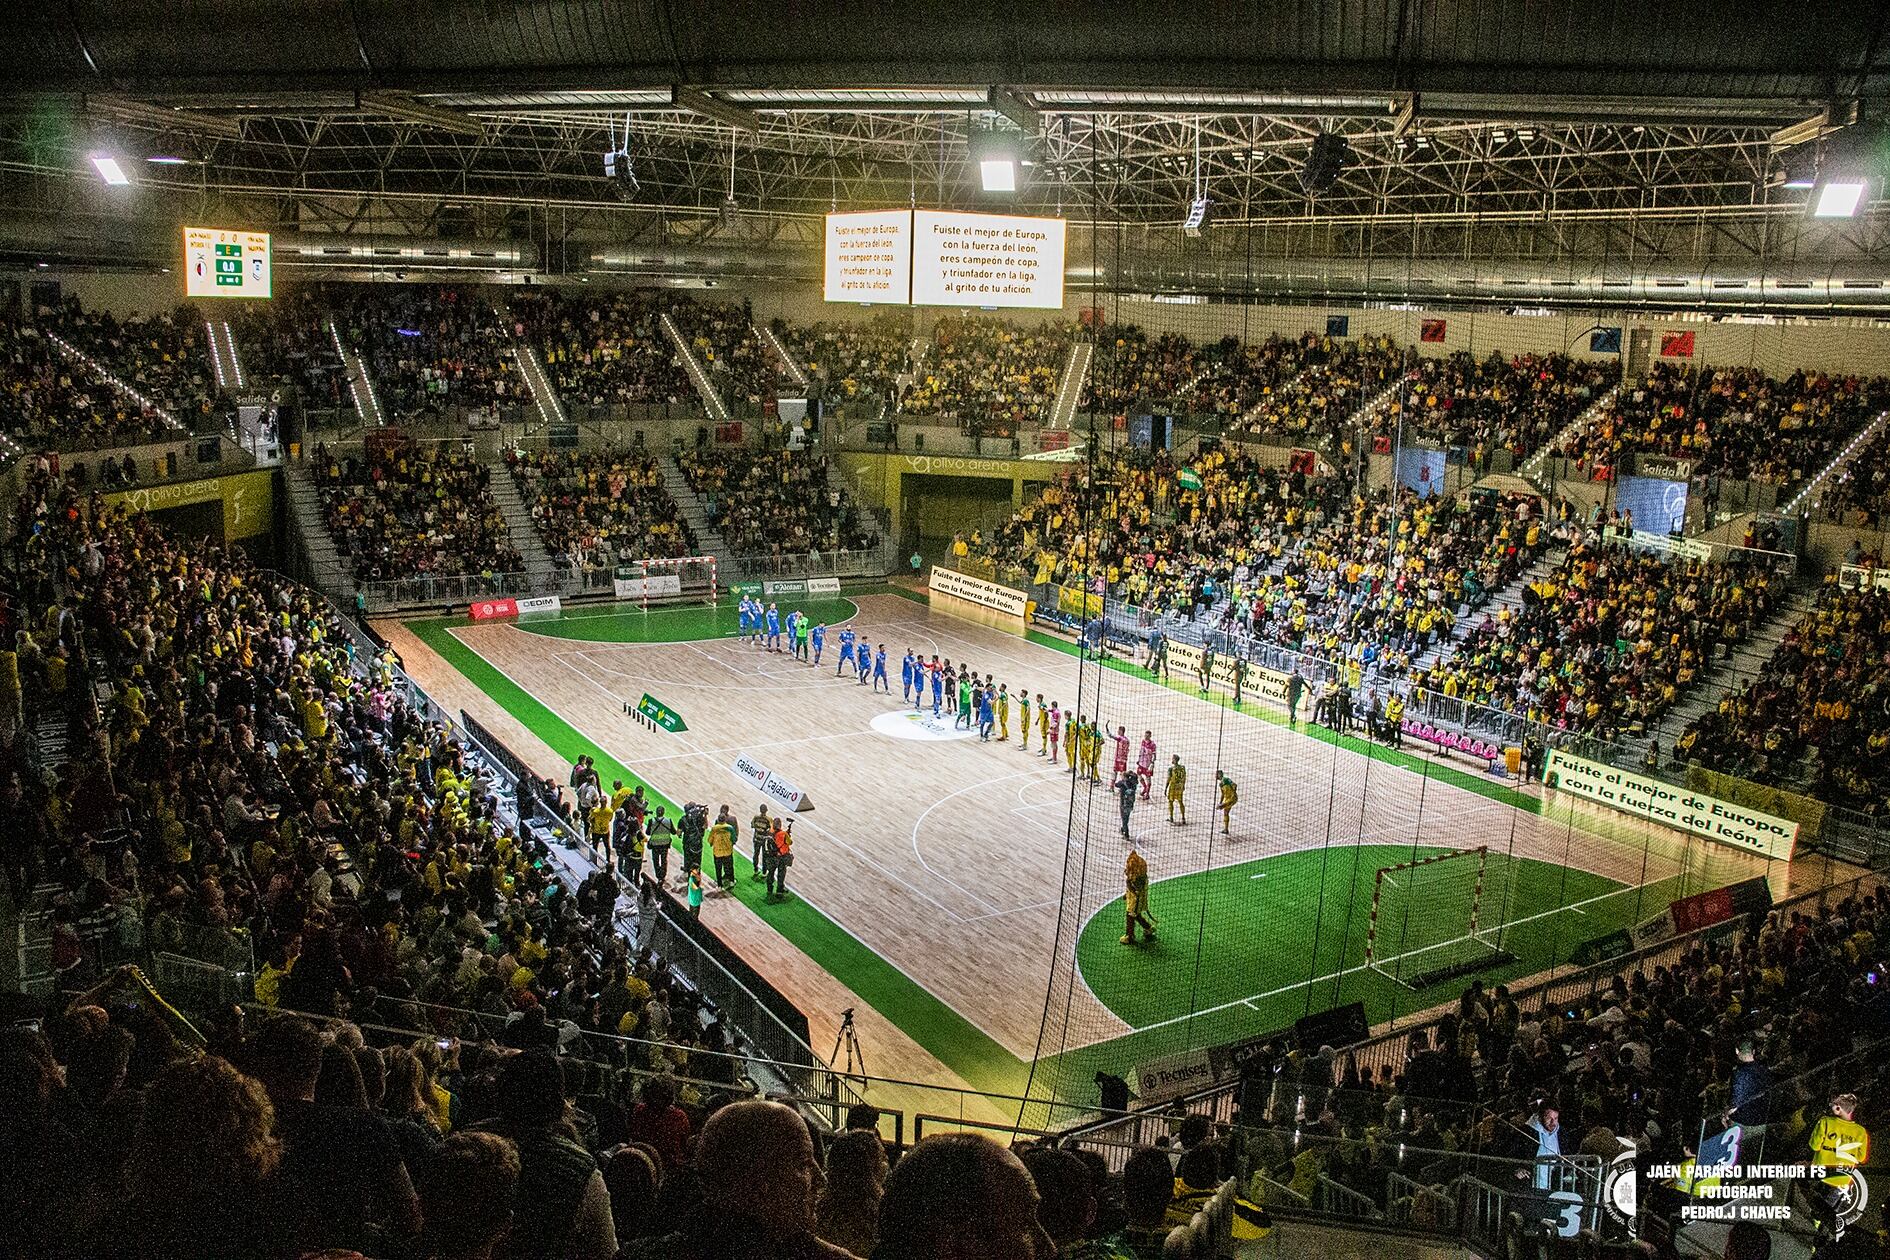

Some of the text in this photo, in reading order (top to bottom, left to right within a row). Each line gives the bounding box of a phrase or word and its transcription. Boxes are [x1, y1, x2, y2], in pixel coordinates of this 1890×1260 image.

[934, 224, 1048, 240] Fuiste el mejor de Europa,
[942, 240, 1038, 254] con la fuerza del león,
[940, 255, 1040, 268] eres campeón de copa,
[942, 270, 947, 279] y
[950, 268, 993, 279] triunfador
[1009, 271, 1017, 280] la
[1019, 272, 1036, 282] liga,
[945, 283, 953, 292] al
[956, 283, 976, 294] grito
[979, 284, 989, 292] de
[236, 390, 280, 403] Salida 6
[776, 389, 799, 397] Salida
[1415, 436, 1440, 446] Salida
[932, 456, 1009, 472] olivo arena
[1643, 463, 1675, 476] Salida
[152, 480, 219, 501] olivo arena
[933, 569, 953, 581] Fuiste
[962, 580, 983, 590] mejor
[984, 585, 994, 594] de
[996, 588, 1025, 604] Europa,
[938, 581, 950, 590] con
[960, 588, 982, 600] fuerza
[984, 596, 995, 605] del
[997, 598, 1015, 611] león,
[1168, 646, 1192, 658] uiste
[1170, 659, 1187, 669] con
[1242, 680, 1258, 691] del
[737, 759, 759, 778] cajasur
[768, 780, 792, 799] cajasur
[1552, 755, 1789, 838] Fuiste el mejor de Europa,
[1565, 778, 1763, 847] con la fuerza del león,
[1156, 1064, 1208, 1084] Tecniseg
[1549, 1191, 1583, 1237] 3
